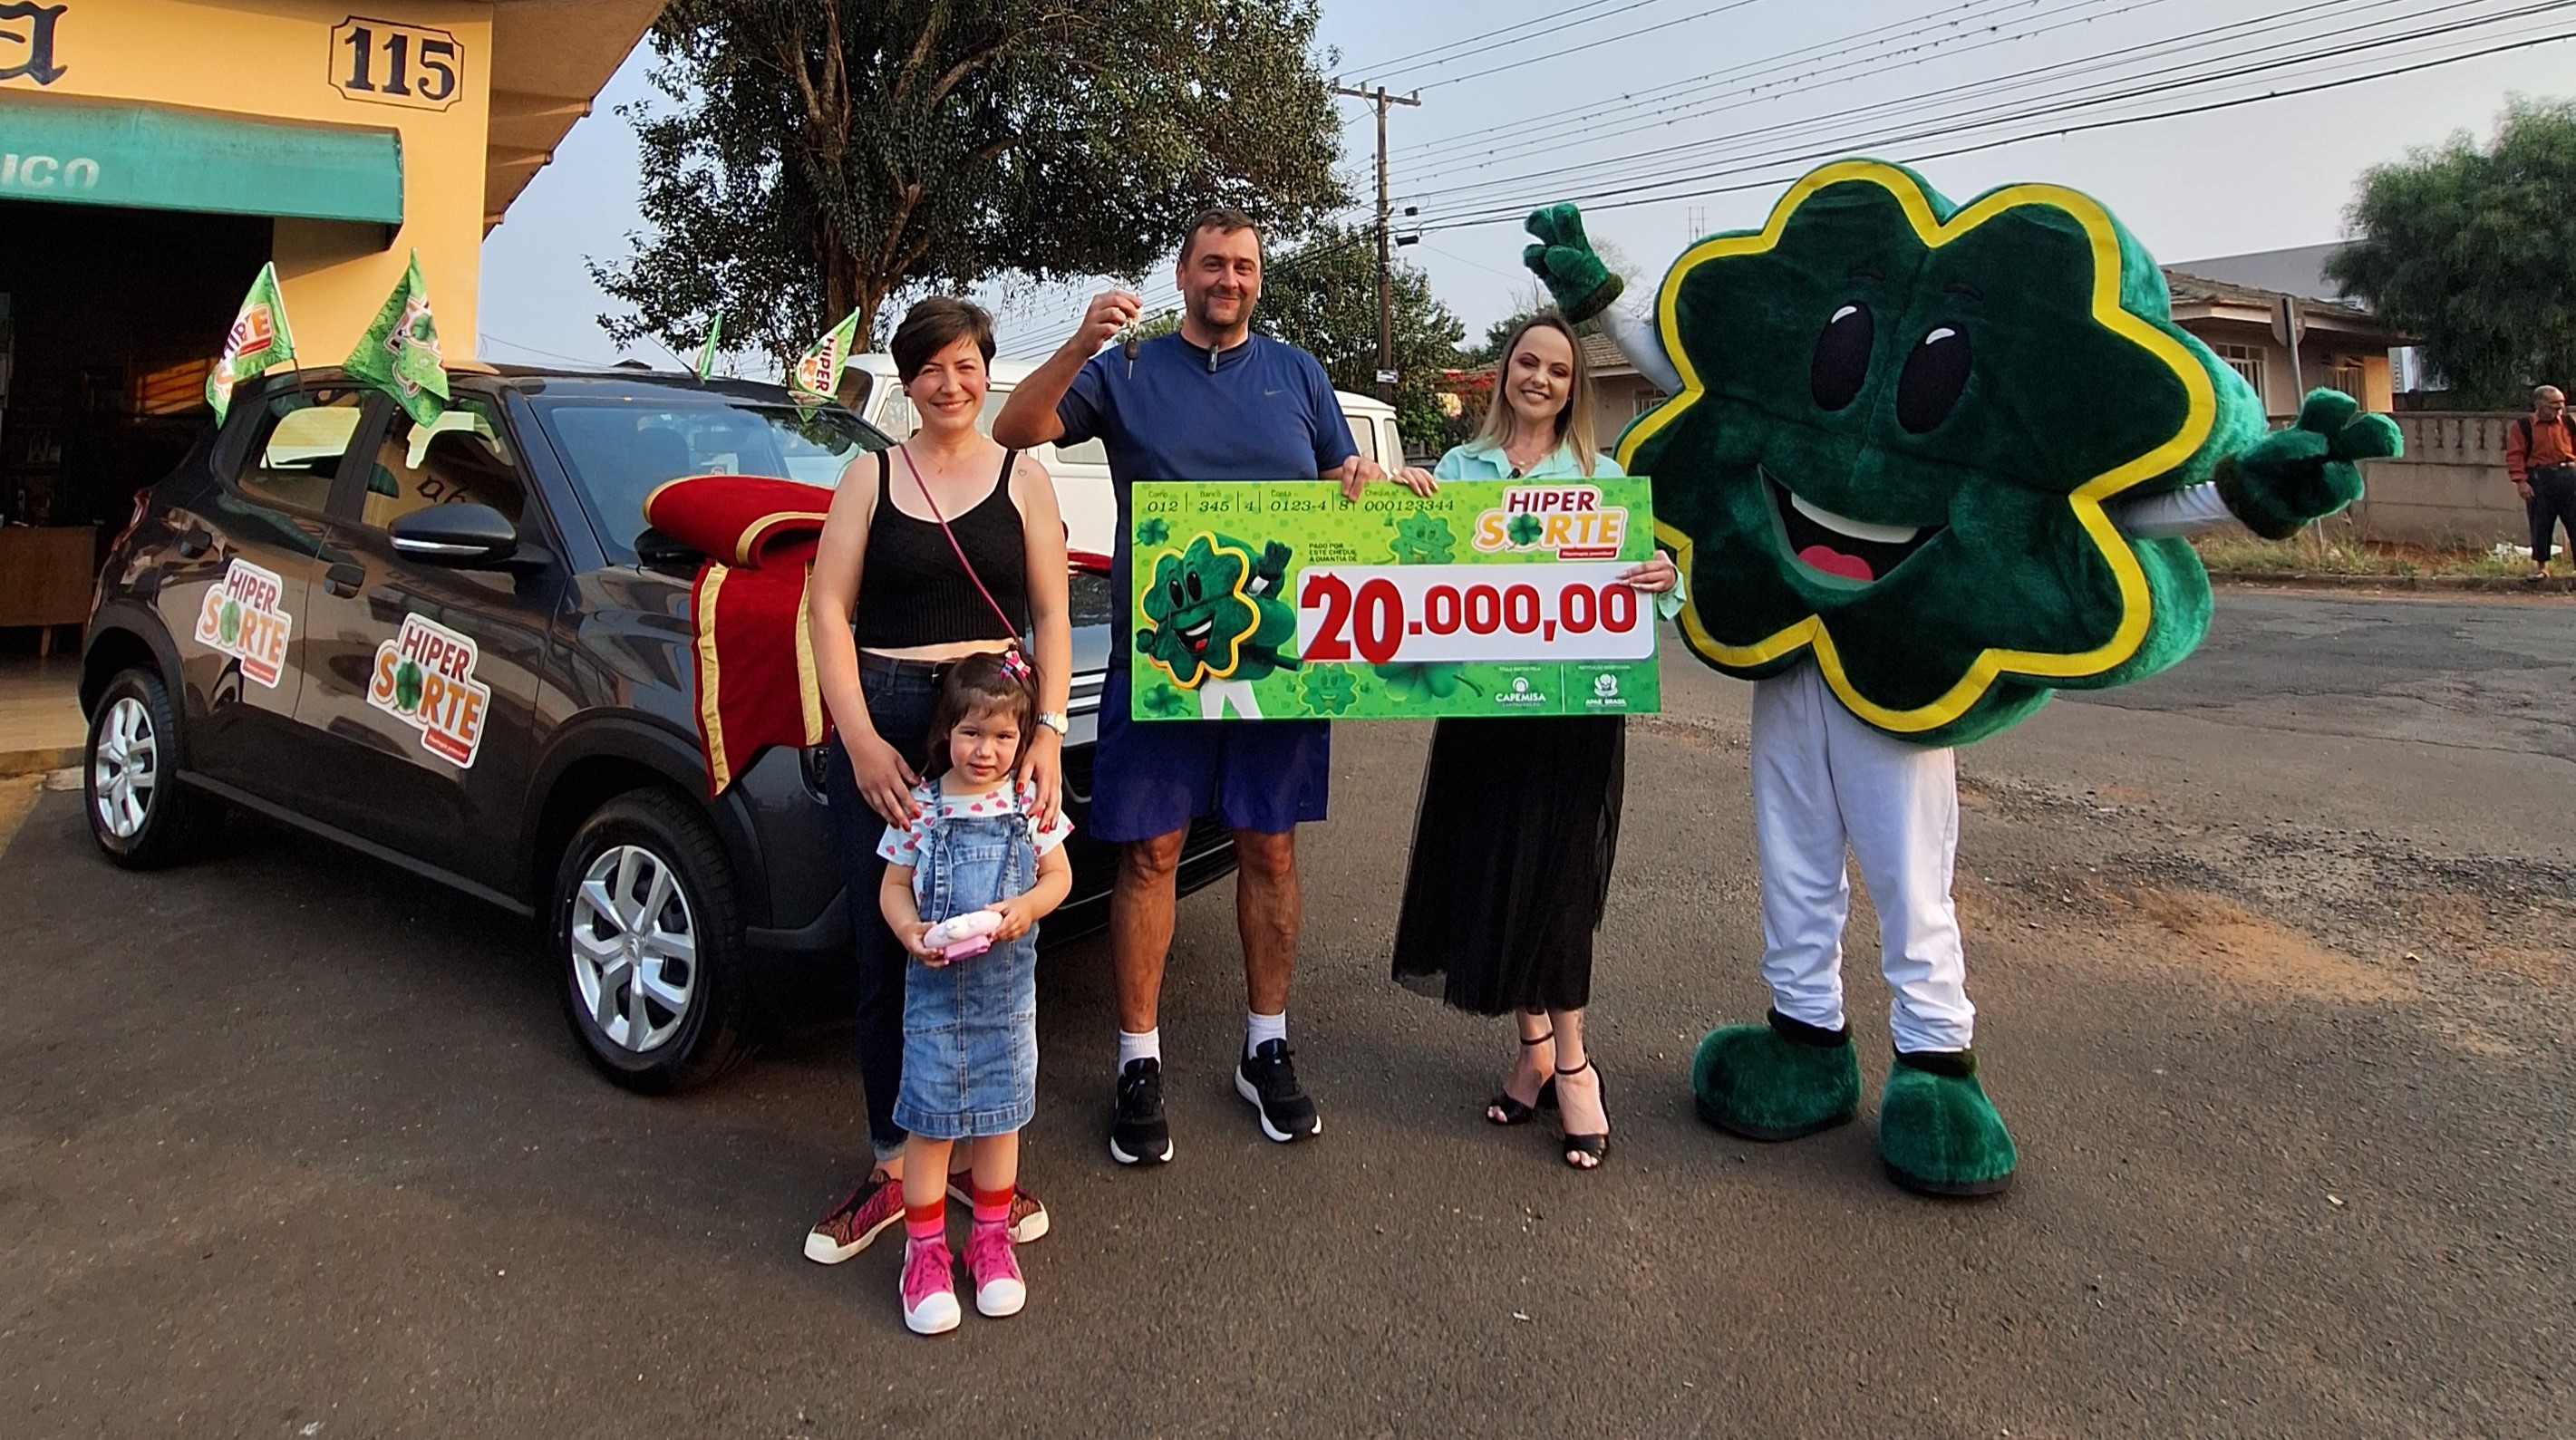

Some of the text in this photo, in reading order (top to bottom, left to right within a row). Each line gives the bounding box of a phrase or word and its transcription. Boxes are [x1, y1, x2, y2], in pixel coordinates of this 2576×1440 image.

[344, 26, 457, 101] 115
[815, 337, 835, 392] HIPER
[1271, 489, 1292, 498] Conta
[1338, 499, 1350, 511] 8
[1507, 490, 1595, 513] HIPER
[1147, 500, 1178, 512] 012
[1198, 500, 1230, 512] 345
[1244, 500, 1254, 512] 4
[1270, 500, 1326, 512] 0123-4
[1364, 499, 1455, 512] 000123344
[1478, 512, 1622, 546] SRTE
[225, 568, 277, 614] HIPER
[202, 594, 286, 664] SRTE
[1301, 572, 1638, 665] 20.000,00
[401, 624, 470, 684] HIPER
[375, 652, 483, 741] SRTE
[1495, 692, 1547, 702] CAPEMISA
